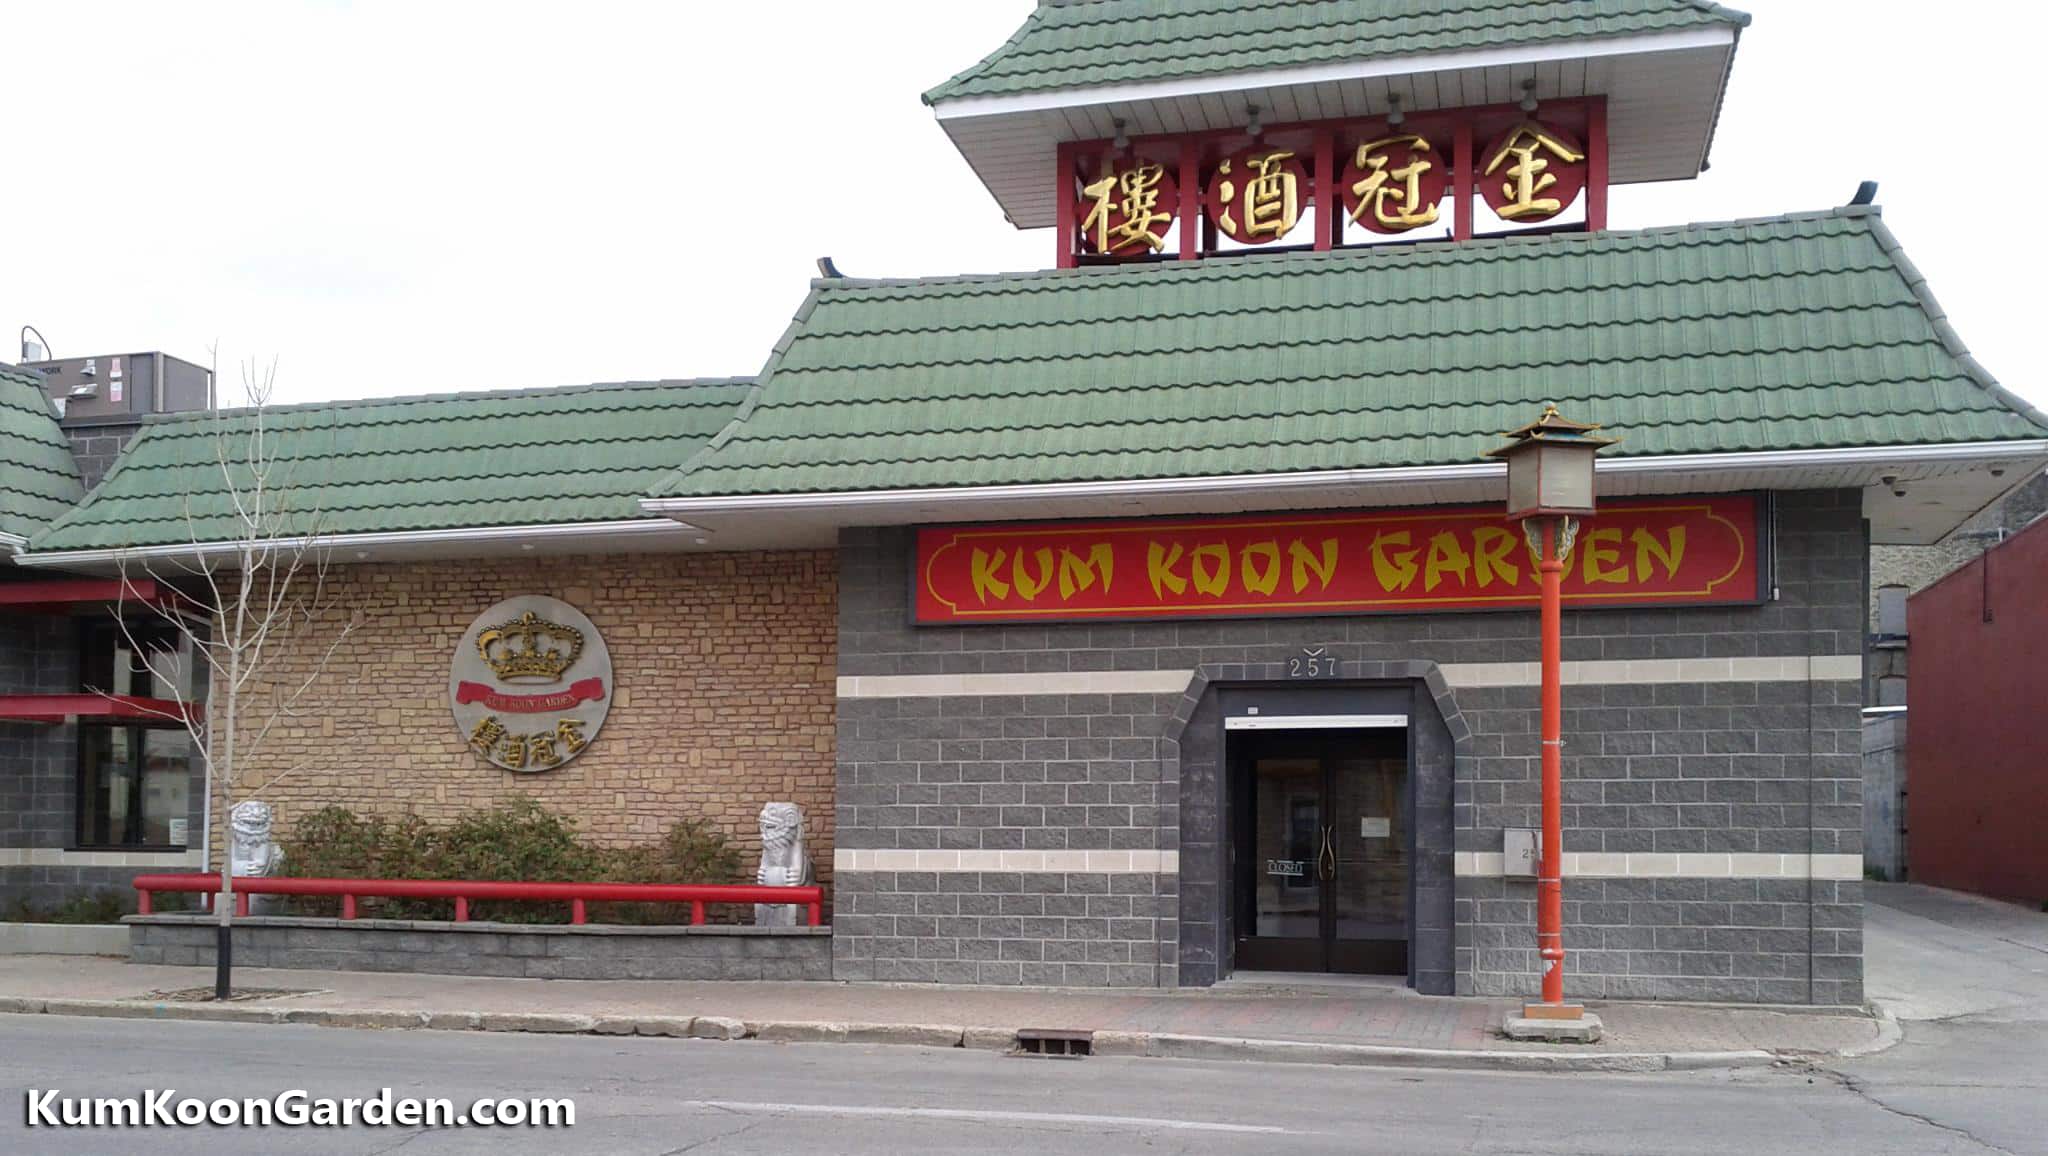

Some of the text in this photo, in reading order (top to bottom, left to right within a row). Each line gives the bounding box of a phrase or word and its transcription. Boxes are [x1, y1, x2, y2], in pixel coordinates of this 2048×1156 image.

[971, 544, 1113, 607] KUM
[1148, 537, 1338, 600] KOON
[1290, 658, 1336, 677] 257
[1268, 862, 1303, 873] CLOSED
